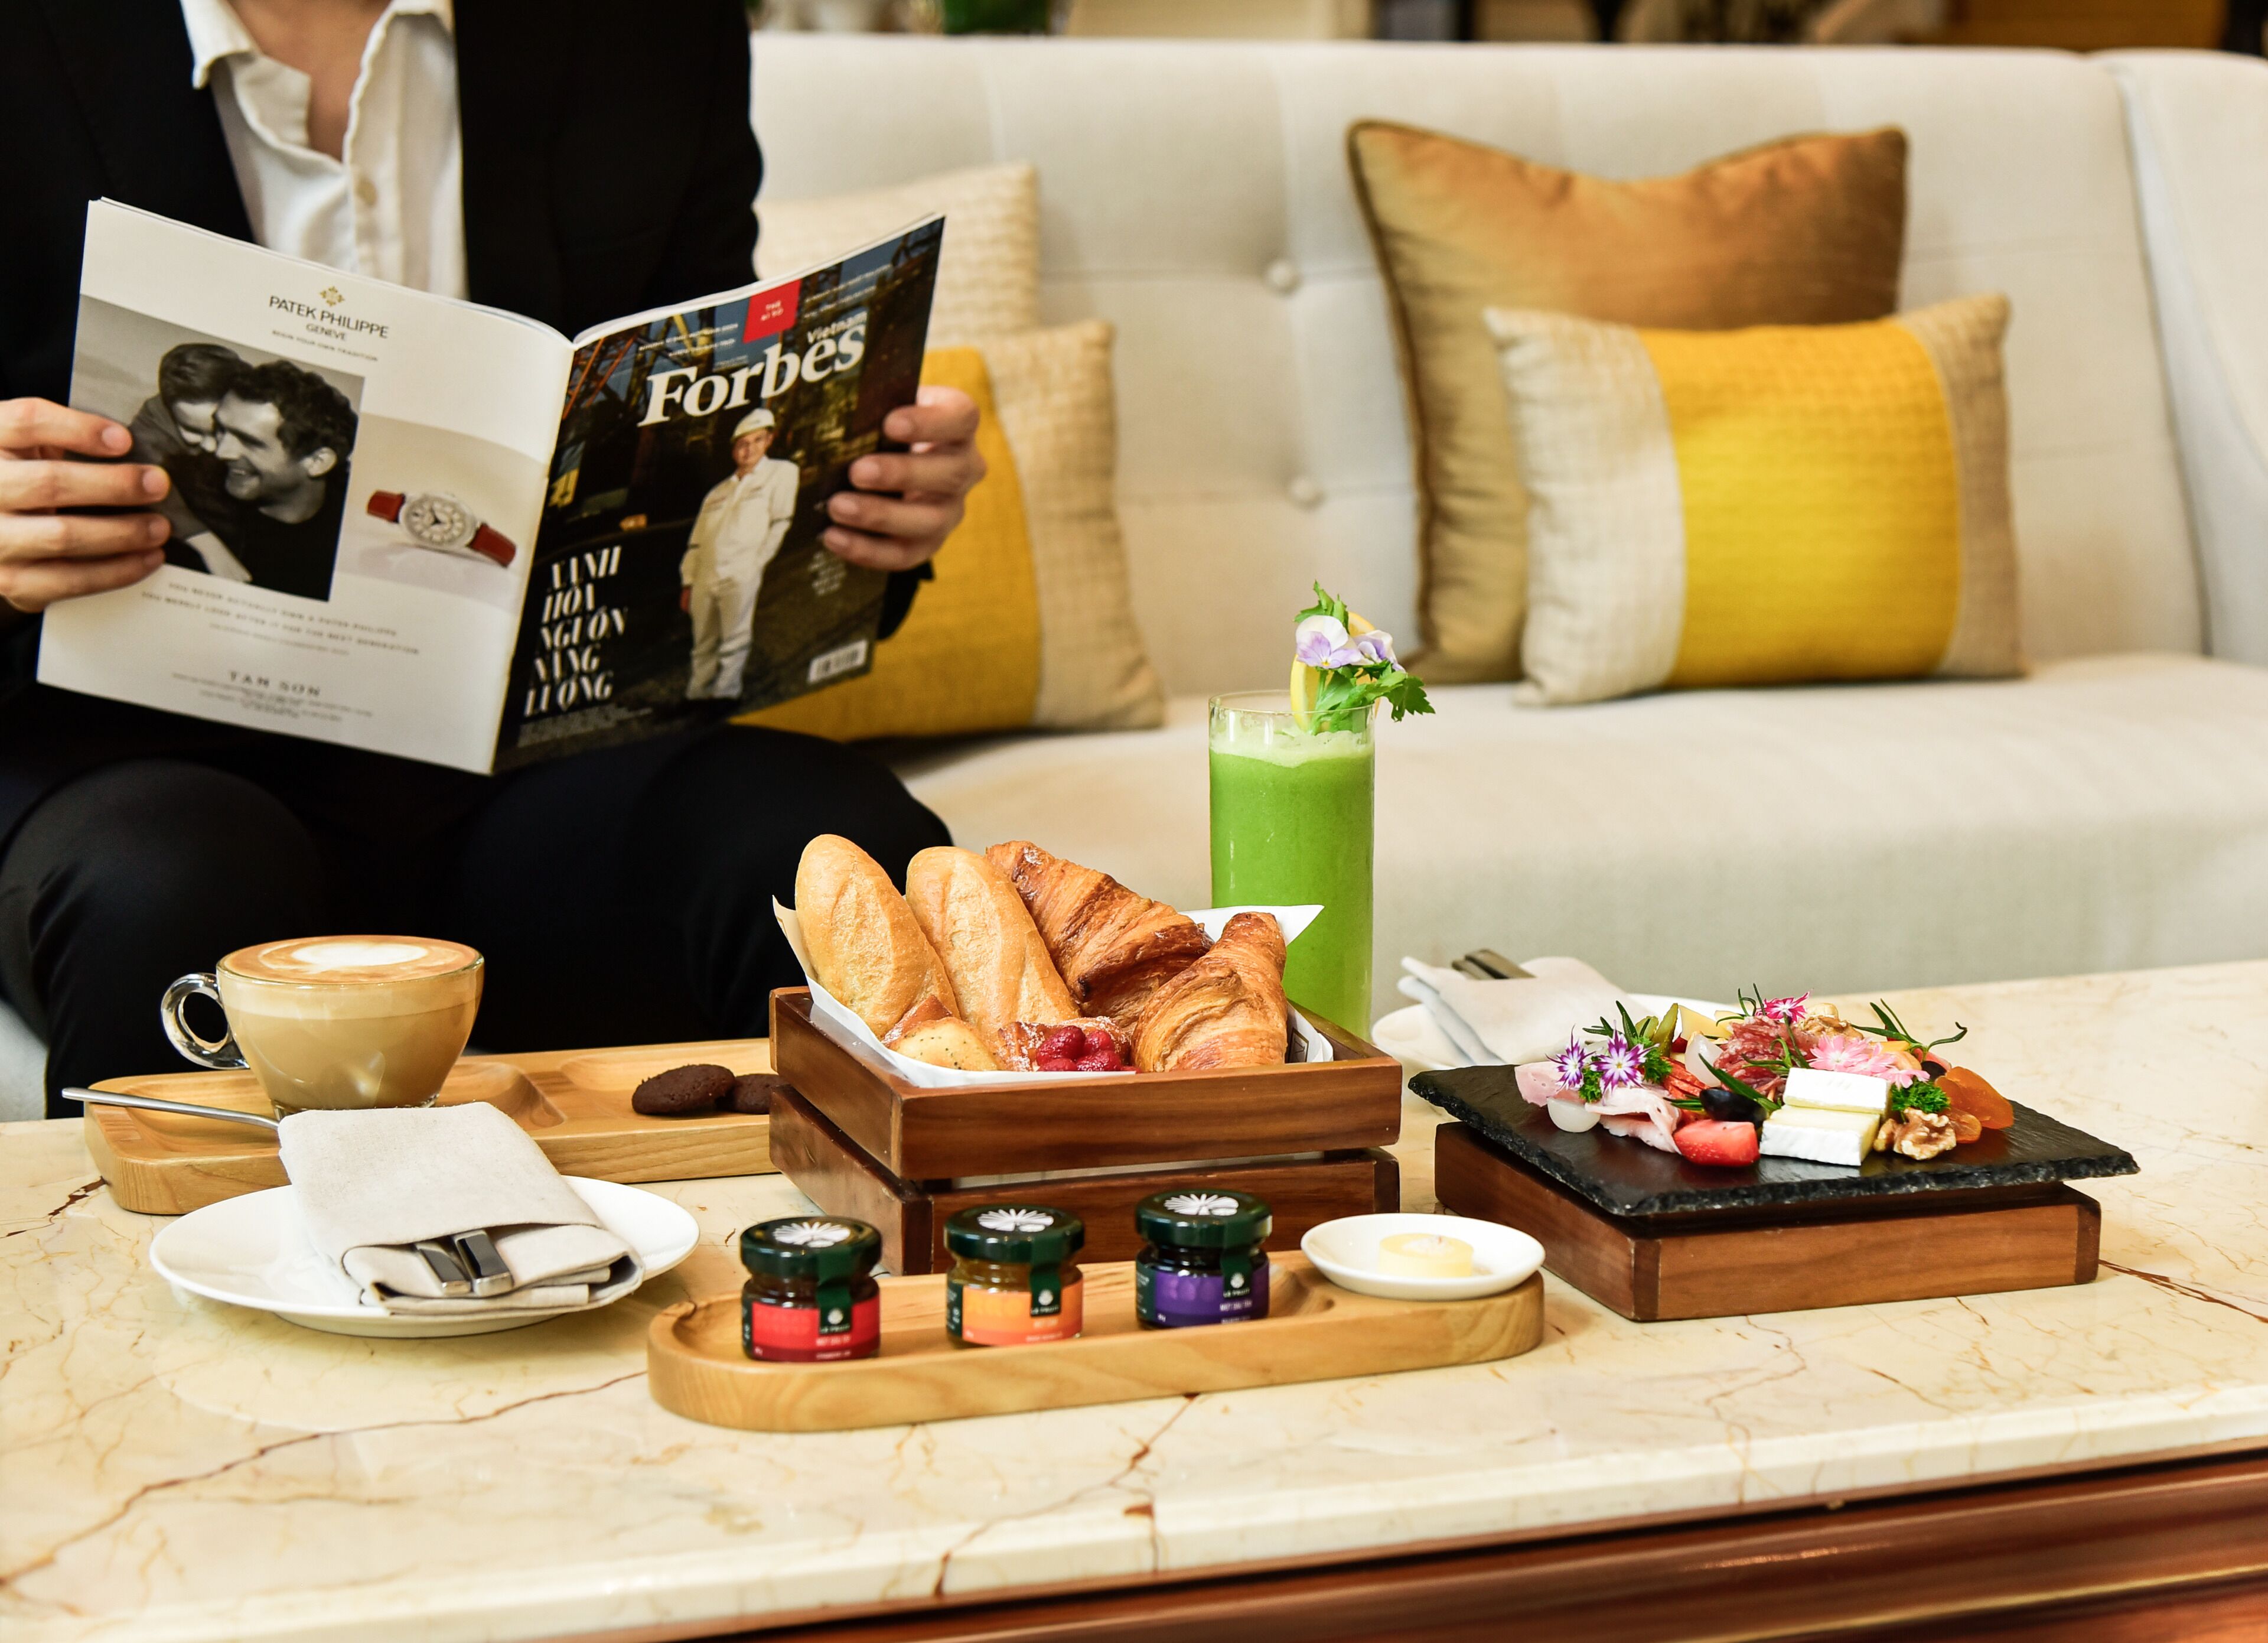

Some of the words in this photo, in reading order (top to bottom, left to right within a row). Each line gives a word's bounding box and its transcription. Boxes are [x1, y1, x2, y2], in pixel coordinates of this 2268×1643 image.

[269, 295, 317, 320] PATEK
[320, 310, 389, 339] PHILIPPE
[807, 311, 868, 344] Vietnam
[637, 324, 867, 428] Forbes
[228, 669, 269, 688] TAM
